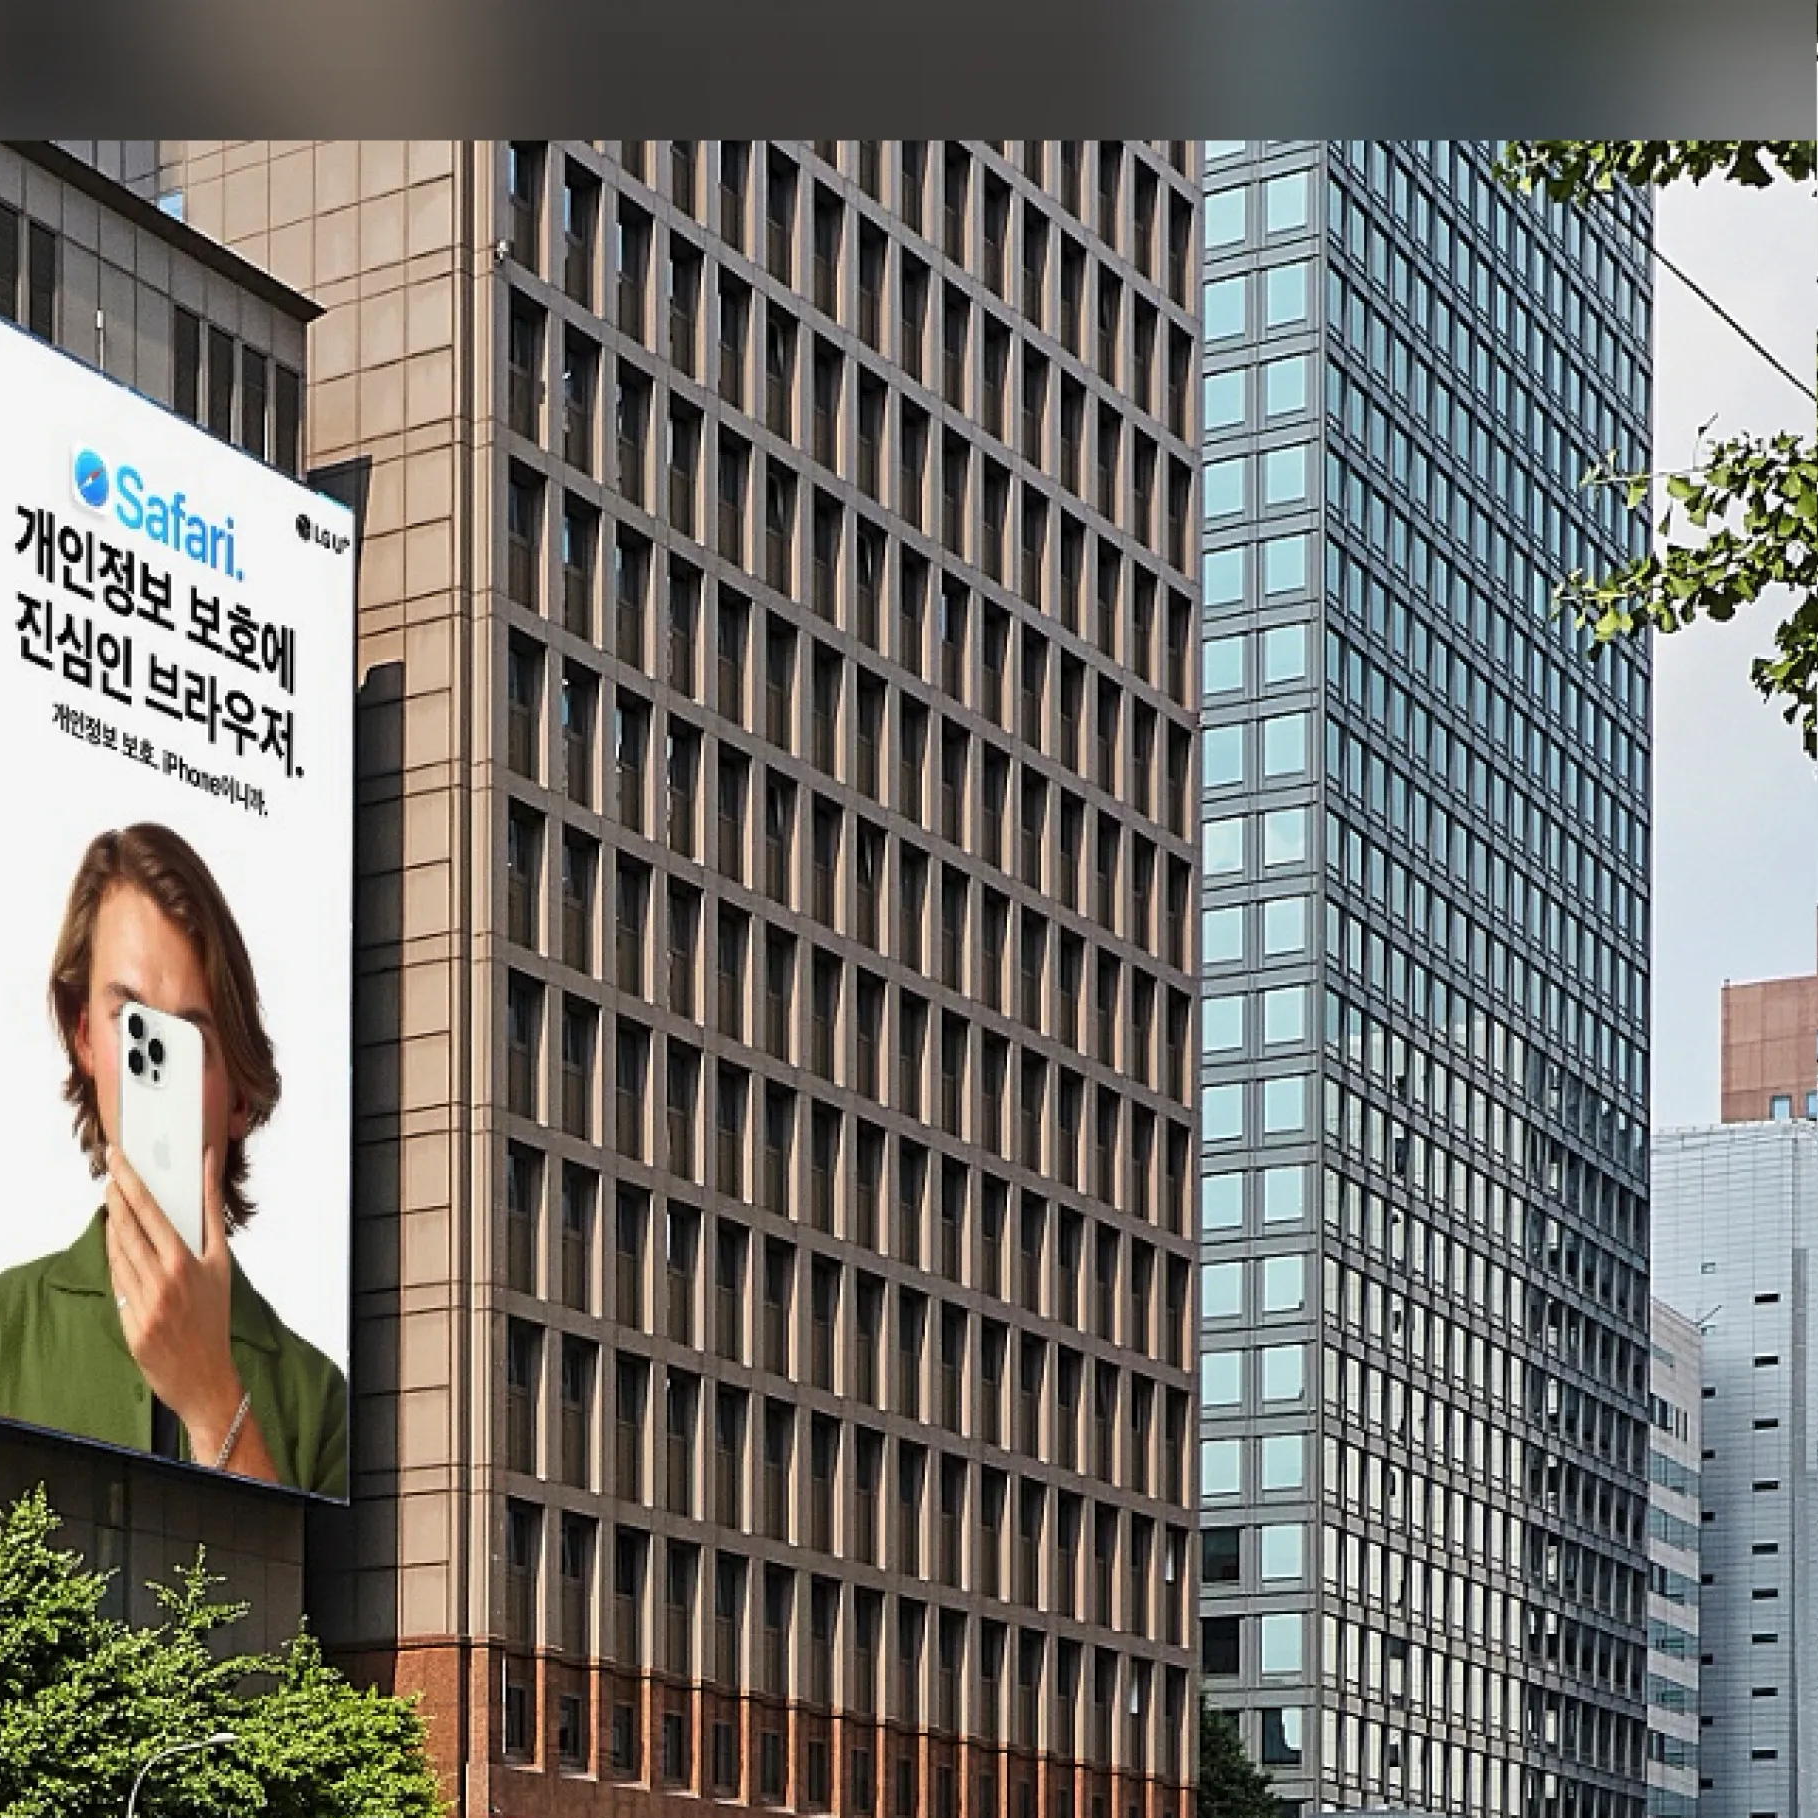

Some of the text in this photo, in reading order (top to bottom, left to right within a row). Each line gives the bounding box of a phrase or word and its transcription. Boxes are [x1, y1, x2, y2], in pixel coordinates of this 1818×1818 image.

[14, 504, 295, 695] 개인정보 보호에
[114, 465, 244, 582] Safari.
[15, 590, 304, 779] 진심인 브라우저.
[52, 702, 117, 751] 개인정보
